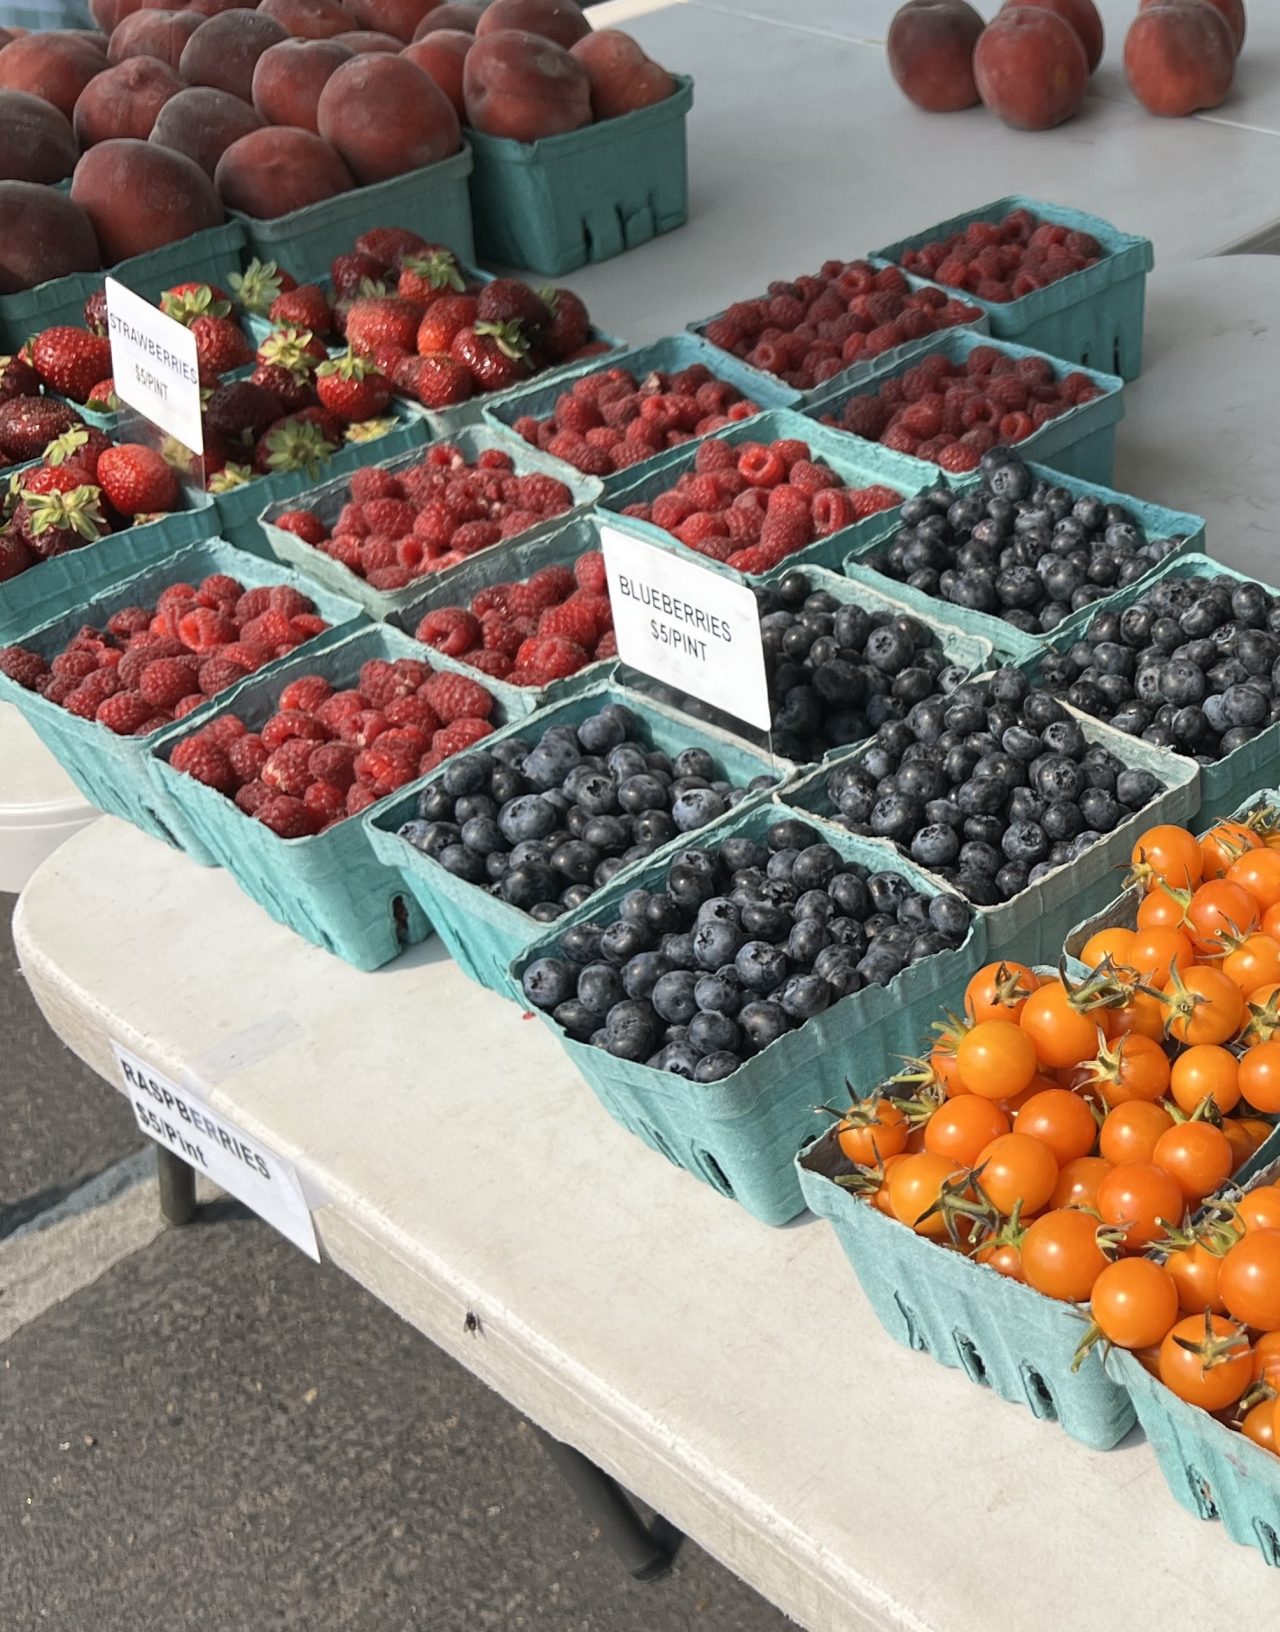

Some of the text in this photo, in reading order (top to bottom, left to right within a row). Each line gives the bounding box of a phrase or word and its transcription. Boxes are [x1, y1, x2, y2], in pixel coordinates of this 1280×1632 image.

[109, 313, 198, 385] STRAWBERRIES
[619, 575, 732, 643] BLUEBERRIES
[651, 618, 707, 662] $5/PINT
[120, 1059, 271, 1180] RASPBERRIES
